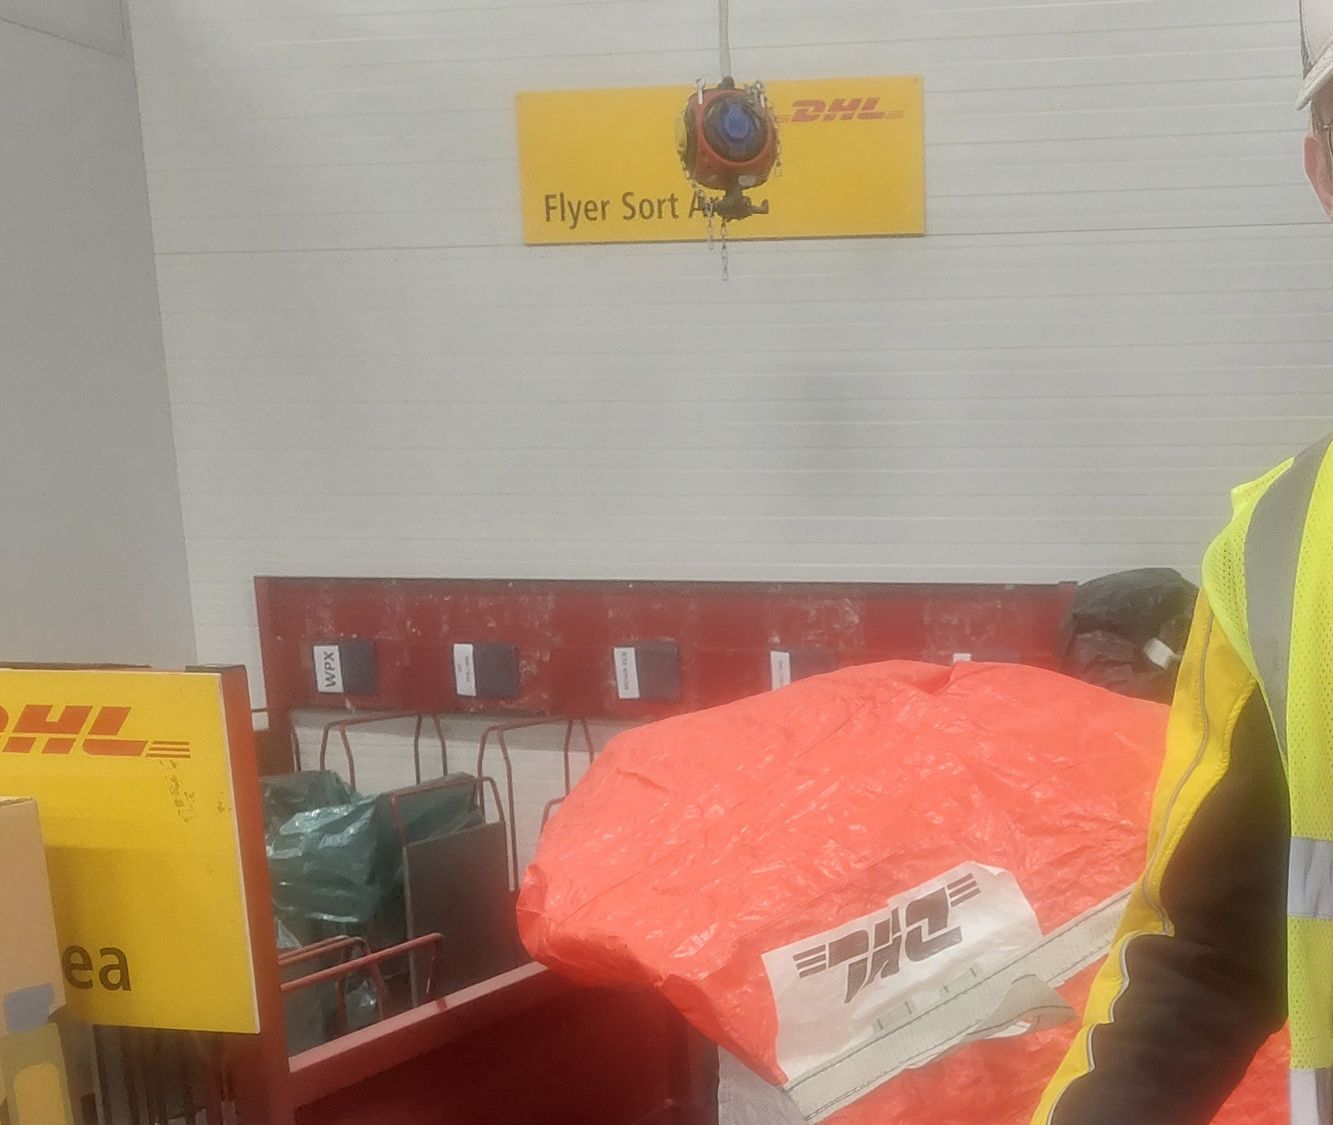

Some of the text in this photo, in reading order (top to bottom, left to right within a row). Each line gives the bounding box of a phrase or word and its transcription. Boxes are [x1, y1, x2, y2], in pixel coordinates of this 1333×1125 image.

[789, 97, 888, 123] DHL
[544, 191, 610, 230] Flyer
[621, 191, 680, 221] Sort
[323, 650, 337, 688] WPX
[0, 703, 150, 757] HL
[822, 884, 965, 1005] DHL
[61, 943, 132, 993] ea
